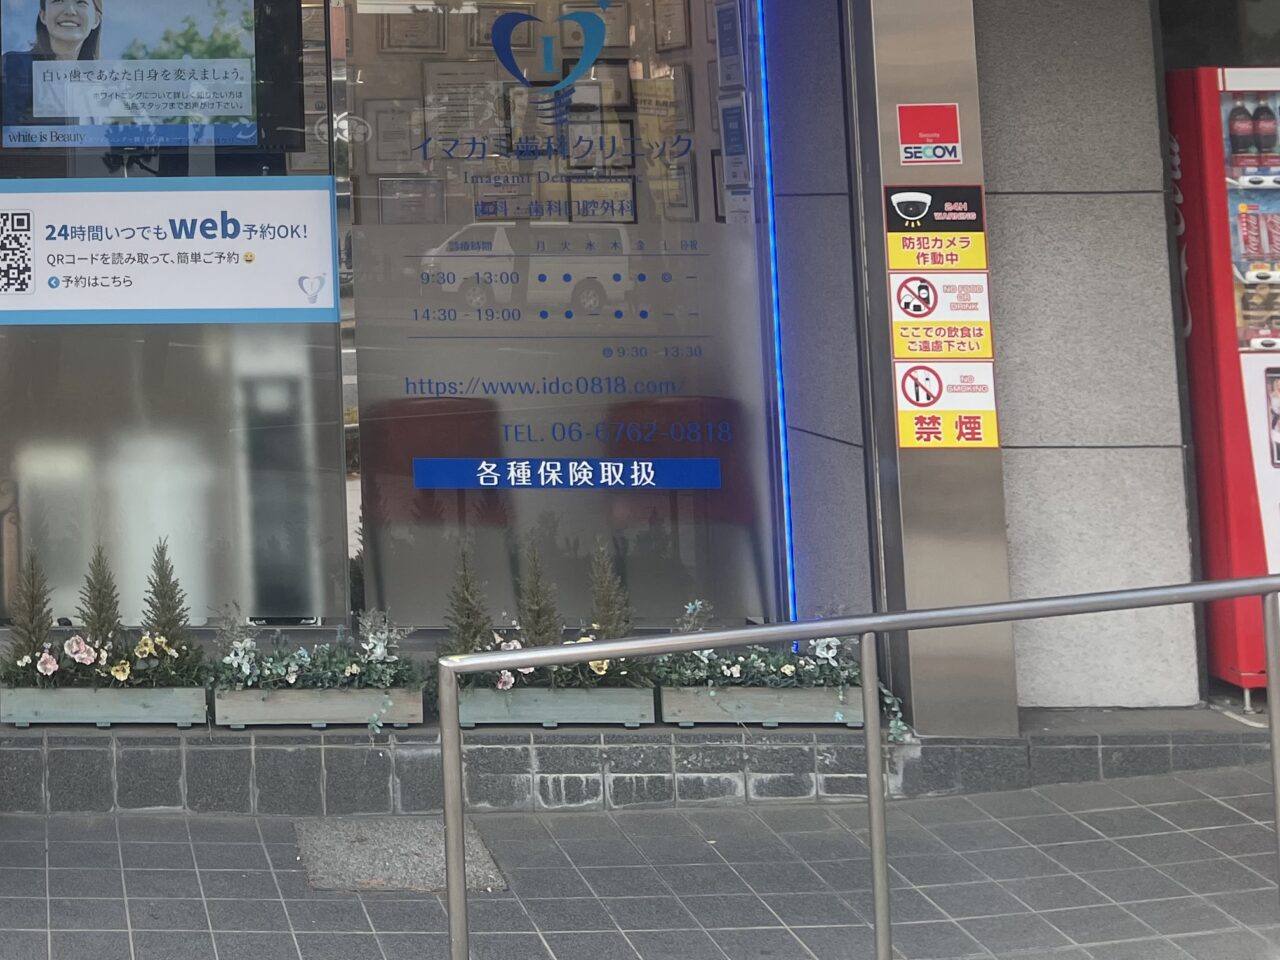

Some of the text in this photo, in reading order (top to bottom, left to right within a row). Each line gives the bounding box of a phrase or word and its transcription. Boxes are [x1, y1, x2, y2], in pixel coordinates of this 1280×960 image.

[42, 67, 245, 83] 白い歯であなた自身を変えましょう。
[8, 131, 37, 143] white
[39, 131, 47, 142] is
[50, 130, 86, 145] Beauty
[412, 134, 692, 161] イマガミ歯科クリニック
[904, 145, 958, 159] SECOM
[464, 169, 531, 186] Imagami
[944, 201, 969, 212] 24H
[933, 211, 977, 221] WARNING
[610, 240, 620, 251] 木
[901, 236, 971, 250] 防犯カメラ
[46, 250, 240, 267] QRコードを読み取って、簡単ご予約
[916, 251, 959, 265] 作動中
[61, 275, 133, 288] 予約はこちら
[420, 271, 456, 285] 9:30
[474, 271, 520, 285] 13:00
[943, 284, 984, 294] NO FOOD
[957, 293, 971, 302] OR
[950, 302, 979, 311] DRINK
[412, 308, 457, 322] 14:30
[476, 308, 521, 322] 19:00
[900, 326, 984, 339] ここでの飲食は
[907, 340, 980, 352] ご遠慮下さい
[960, 375, 974, 384] NO
[405, 376, 686, 398] https://www.idc0818.com/
[946, 384, 989, 393] SMOKING
[502, 421, 733, 443] TEL. 06-6762-0818
[914, 415, 983, 442] 禁煙
[476, 459, 658, 488] 各種保険取扱
